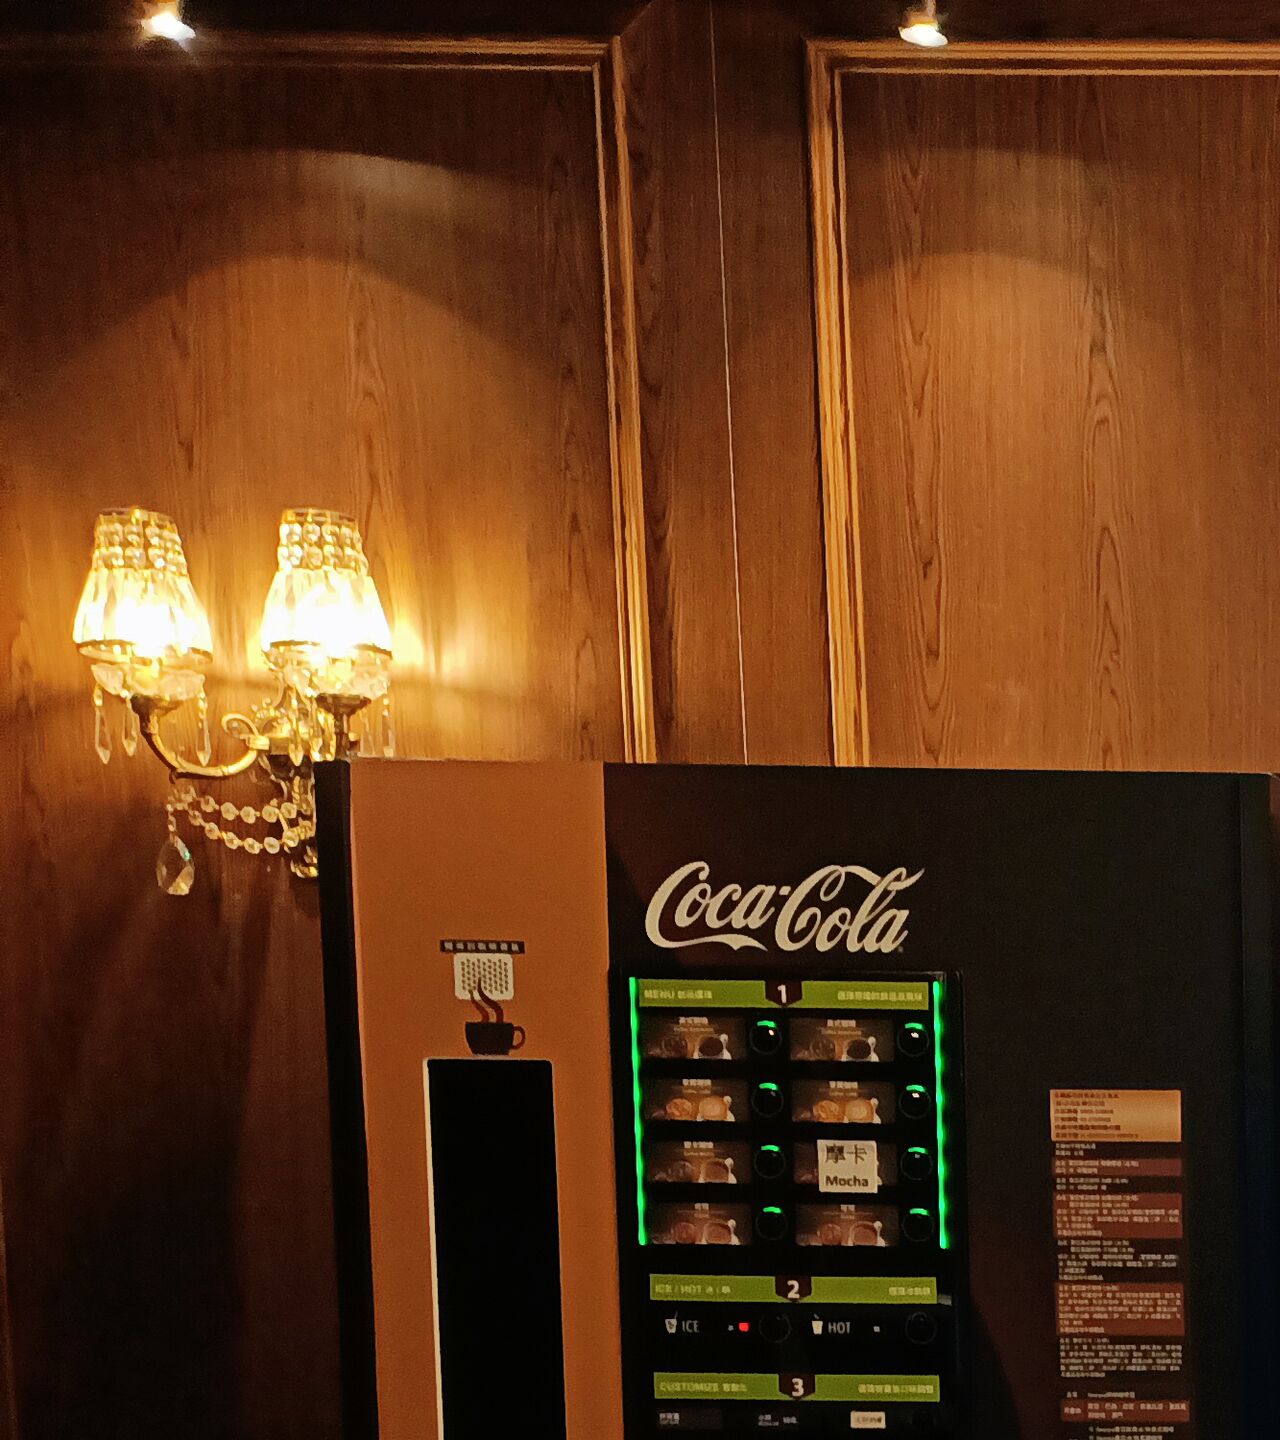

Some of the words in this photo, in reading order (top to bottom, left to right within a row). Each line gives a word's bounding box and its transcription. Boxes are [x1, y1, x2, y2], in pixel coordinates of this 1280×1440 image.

[644, 861, 925, 953] Coca-Cola
[777, 984, 788, 1004] 1
[825, 1143, 868, 1165] 摩卡
[825, 1174, 870, 1188] Mocha
[787, 1280, 800, 1299] 2
[682, 1322, 699, 1333] ICE
[828, 1321, 851, 1333] HOT
[791, 1378, 804, 1396] 3
